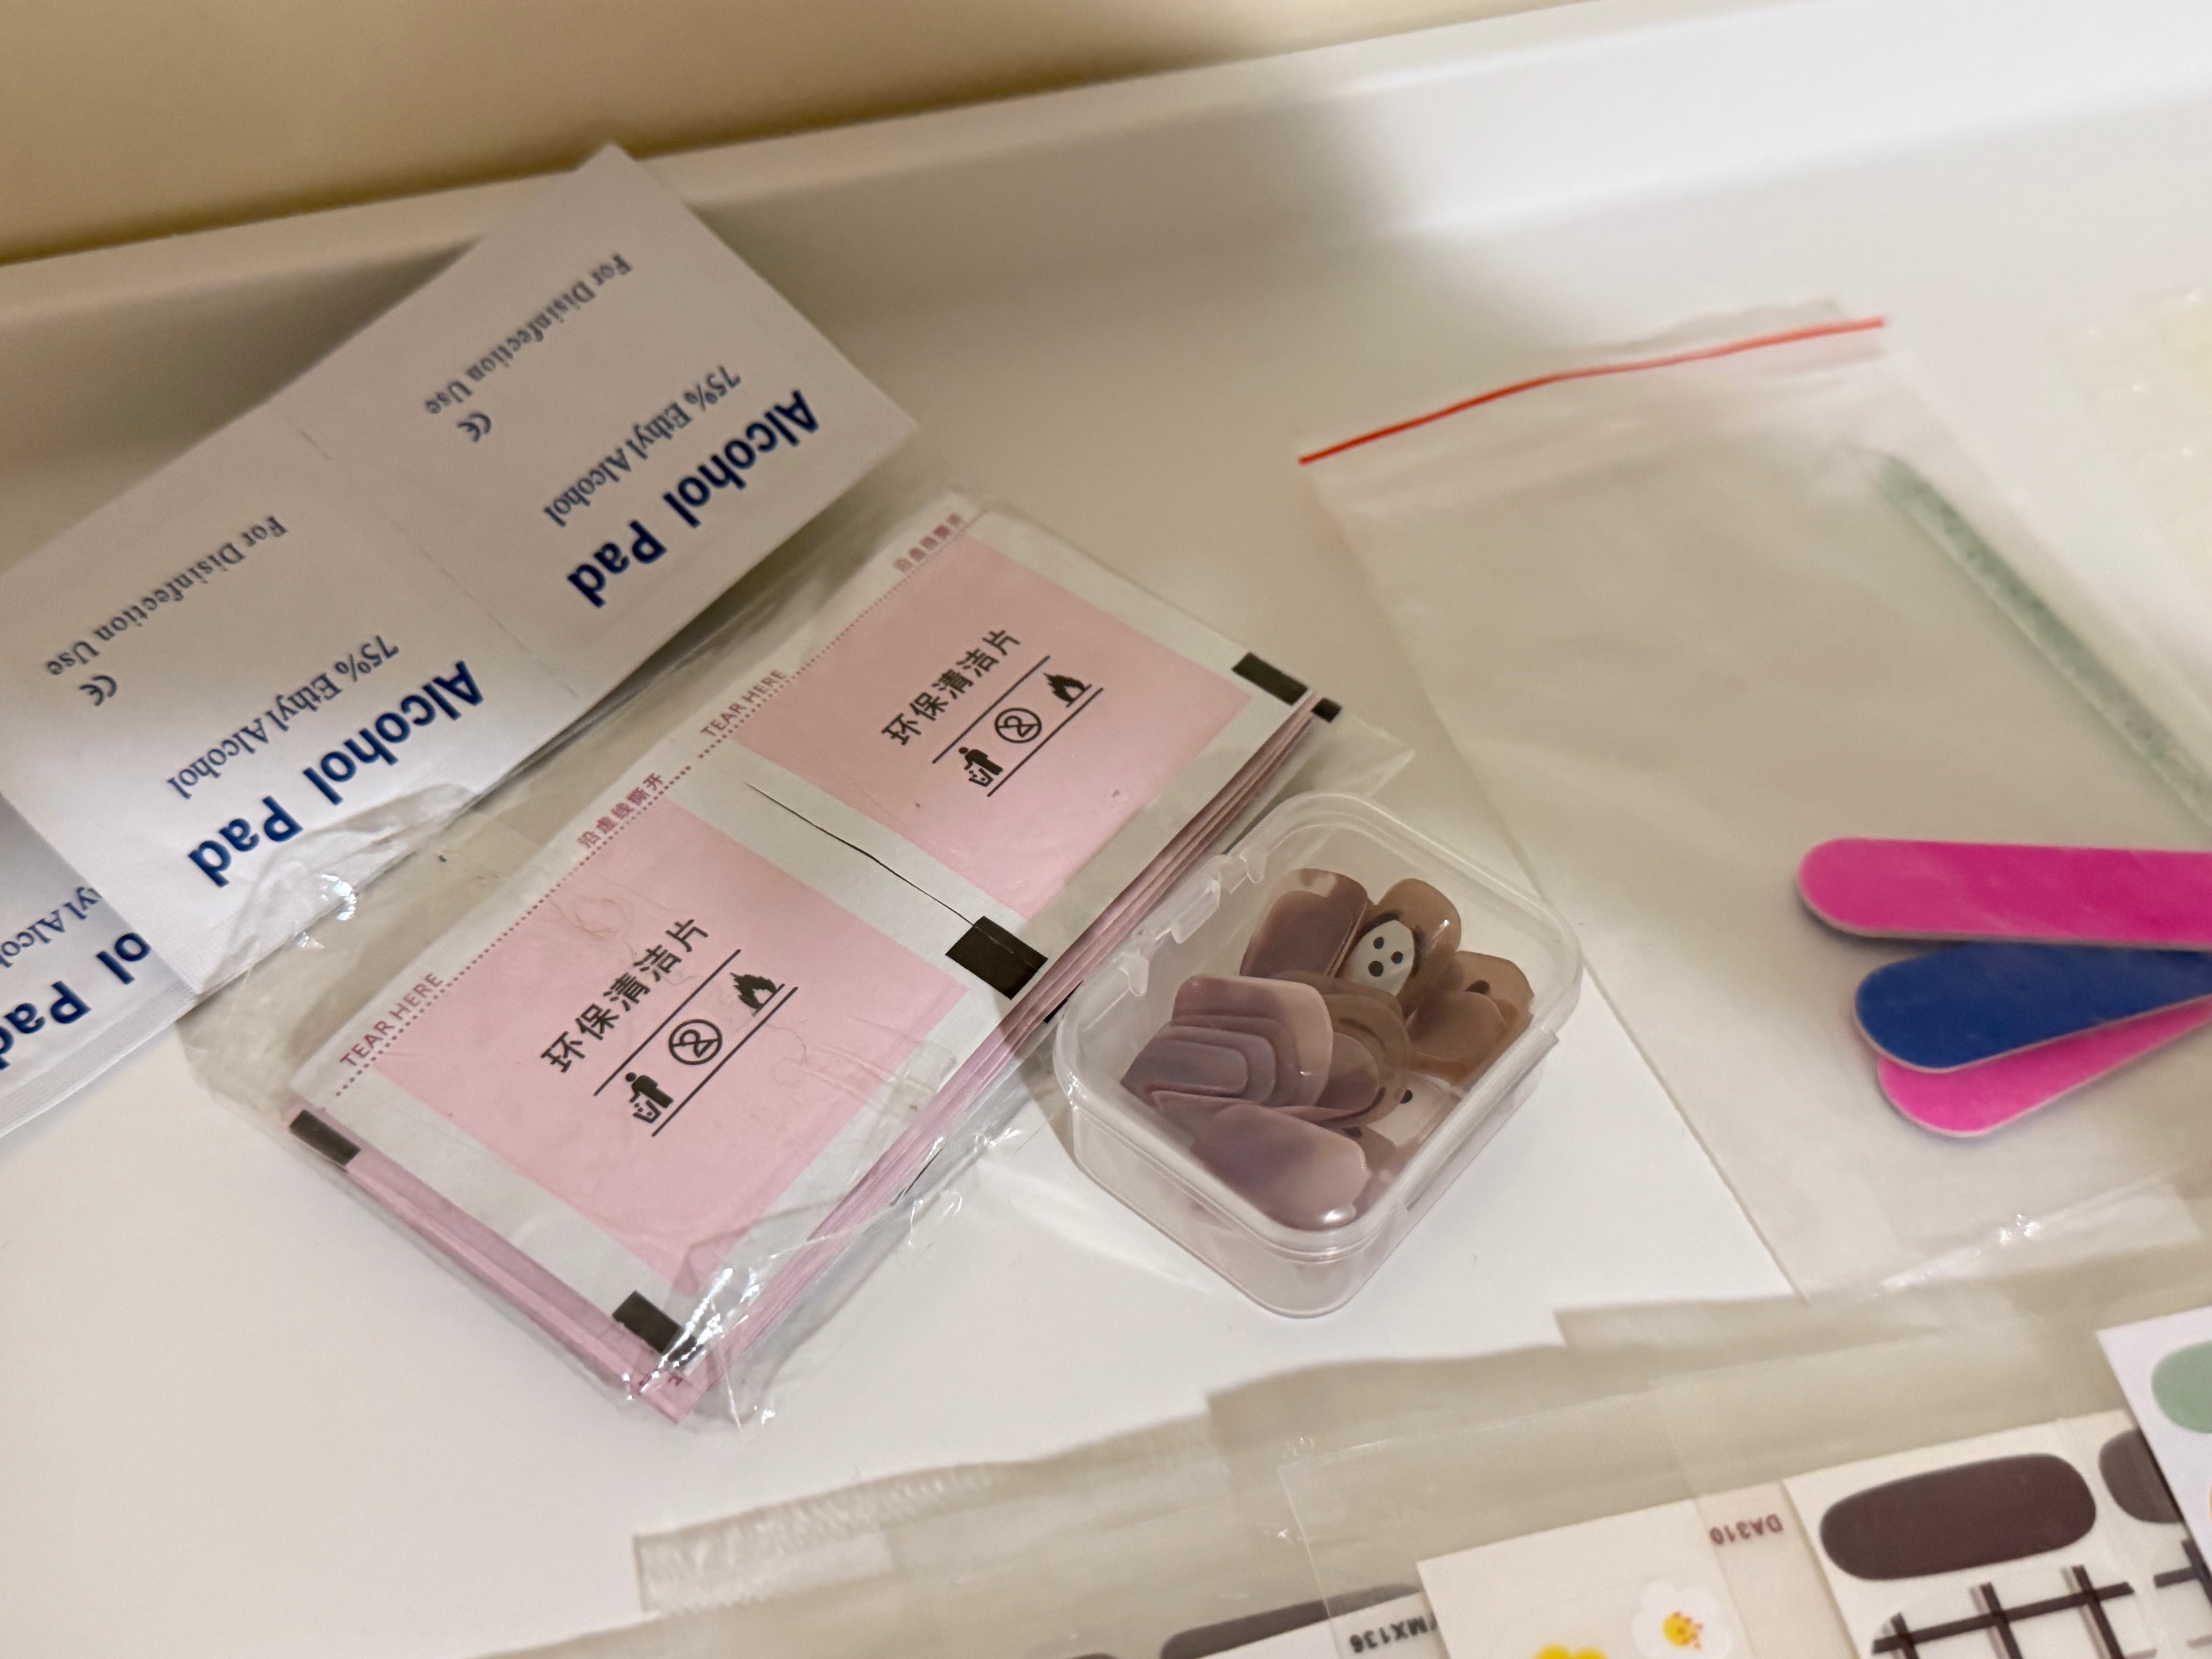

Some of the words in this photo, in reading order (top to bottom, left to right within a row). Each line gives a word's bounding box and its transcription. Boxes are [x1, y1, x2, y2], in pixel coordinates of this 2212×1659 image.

[593, 253, 633, 287] For
[466, 280, 597, 382] Disinfection
[424, 379, 473, 416] Use
[683, 364, 741, 411] 75%
[625, 402, 694, 460] Ethyl
[662, 388, 819, 529] Alcohol
[542, 448, 632, 528] Alcohol
[243, 515, 289, 549] For
[566, 519, 667, 609] Pad
[93, 542, 246, 643] Disinfection
[46, 640, 100, 676] Use
[335, 634, 400, 683] 75%
[881, 629, 1020, 746] 环保清洁片
[264, 673, 344, 733] Ethyl
[302, 660, 485, 805] Alcohol
[700, 702, 746, 739] TEAR
[743, 669, 786, 704] HERE
[166, 716, 269, 799] Alcohol
[188, 796, 303, 888] Pad
[64, 887, 103, 919] yl
[339, 1019, 395, 1070] TEAR
[390, 973, 445, 1020] HERE
[540, 917, 709, 1074] 环保清洁片
